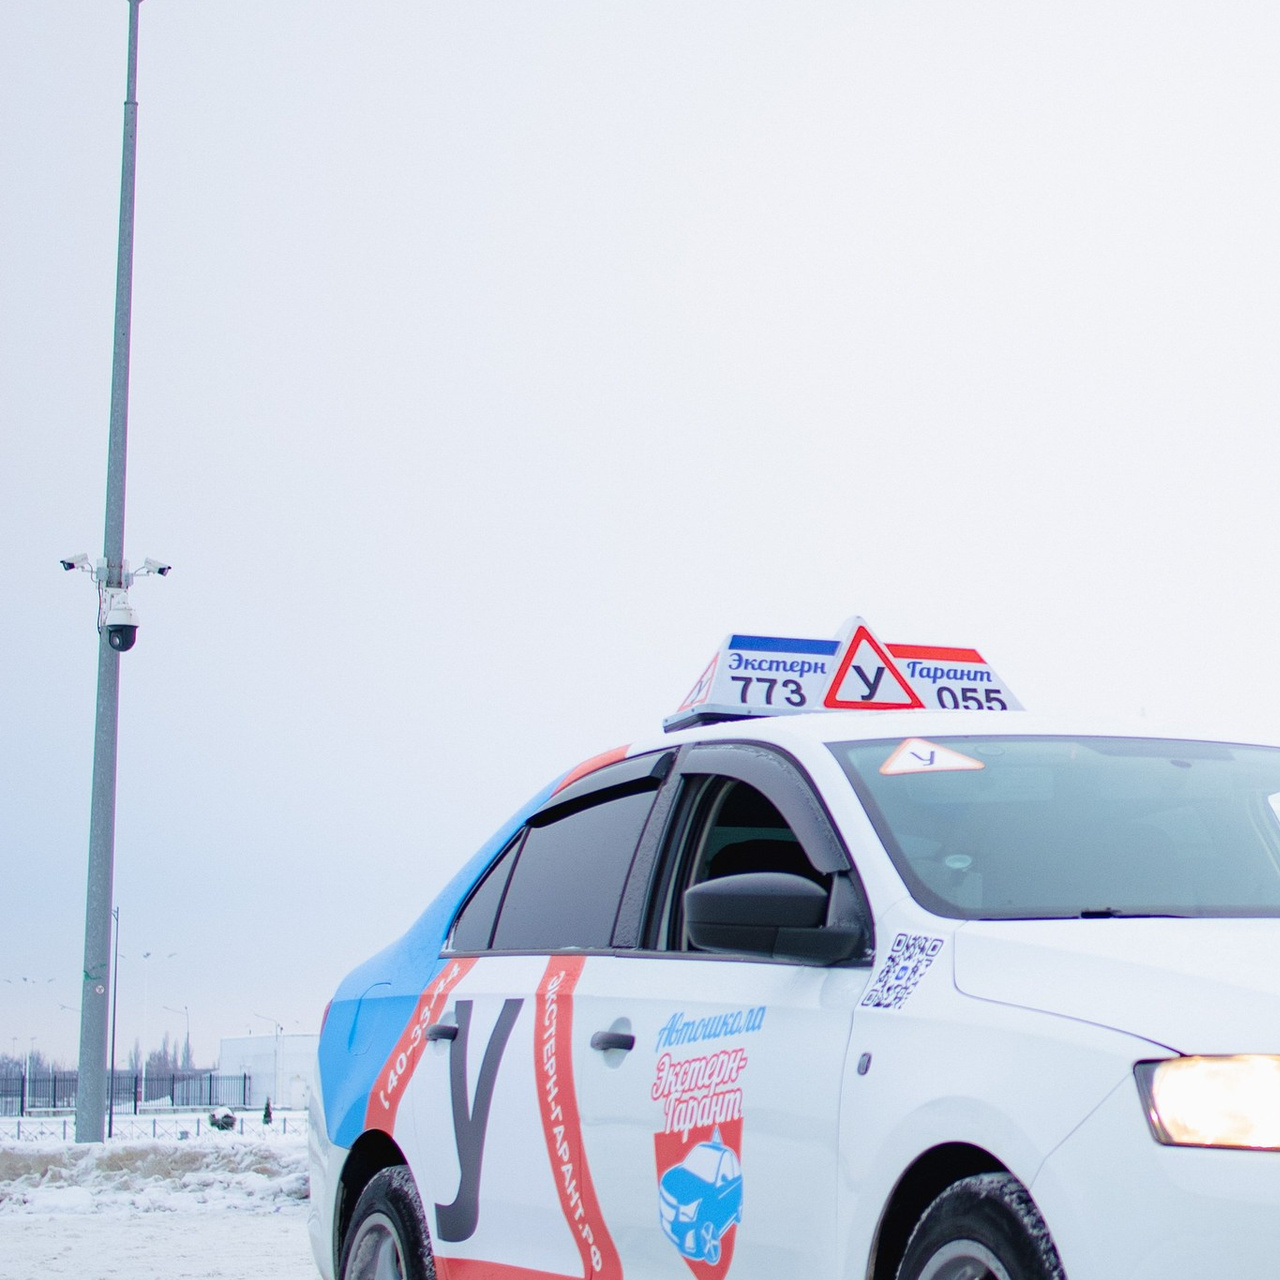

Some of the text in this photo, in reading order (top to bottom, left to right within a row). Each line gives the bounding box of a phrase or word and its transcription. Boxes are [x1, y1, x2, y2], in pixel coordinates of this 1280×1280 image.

[728, 652, 827, 678] Экстерн
[907, 661, 992, 684] Гарант
[731, 676, 807, 707] 773
[936, 686, 1007, 711] 055
[655, 1005, 766, 1052] Автошкола
[664, 1087, 743, 1144] Гарант
